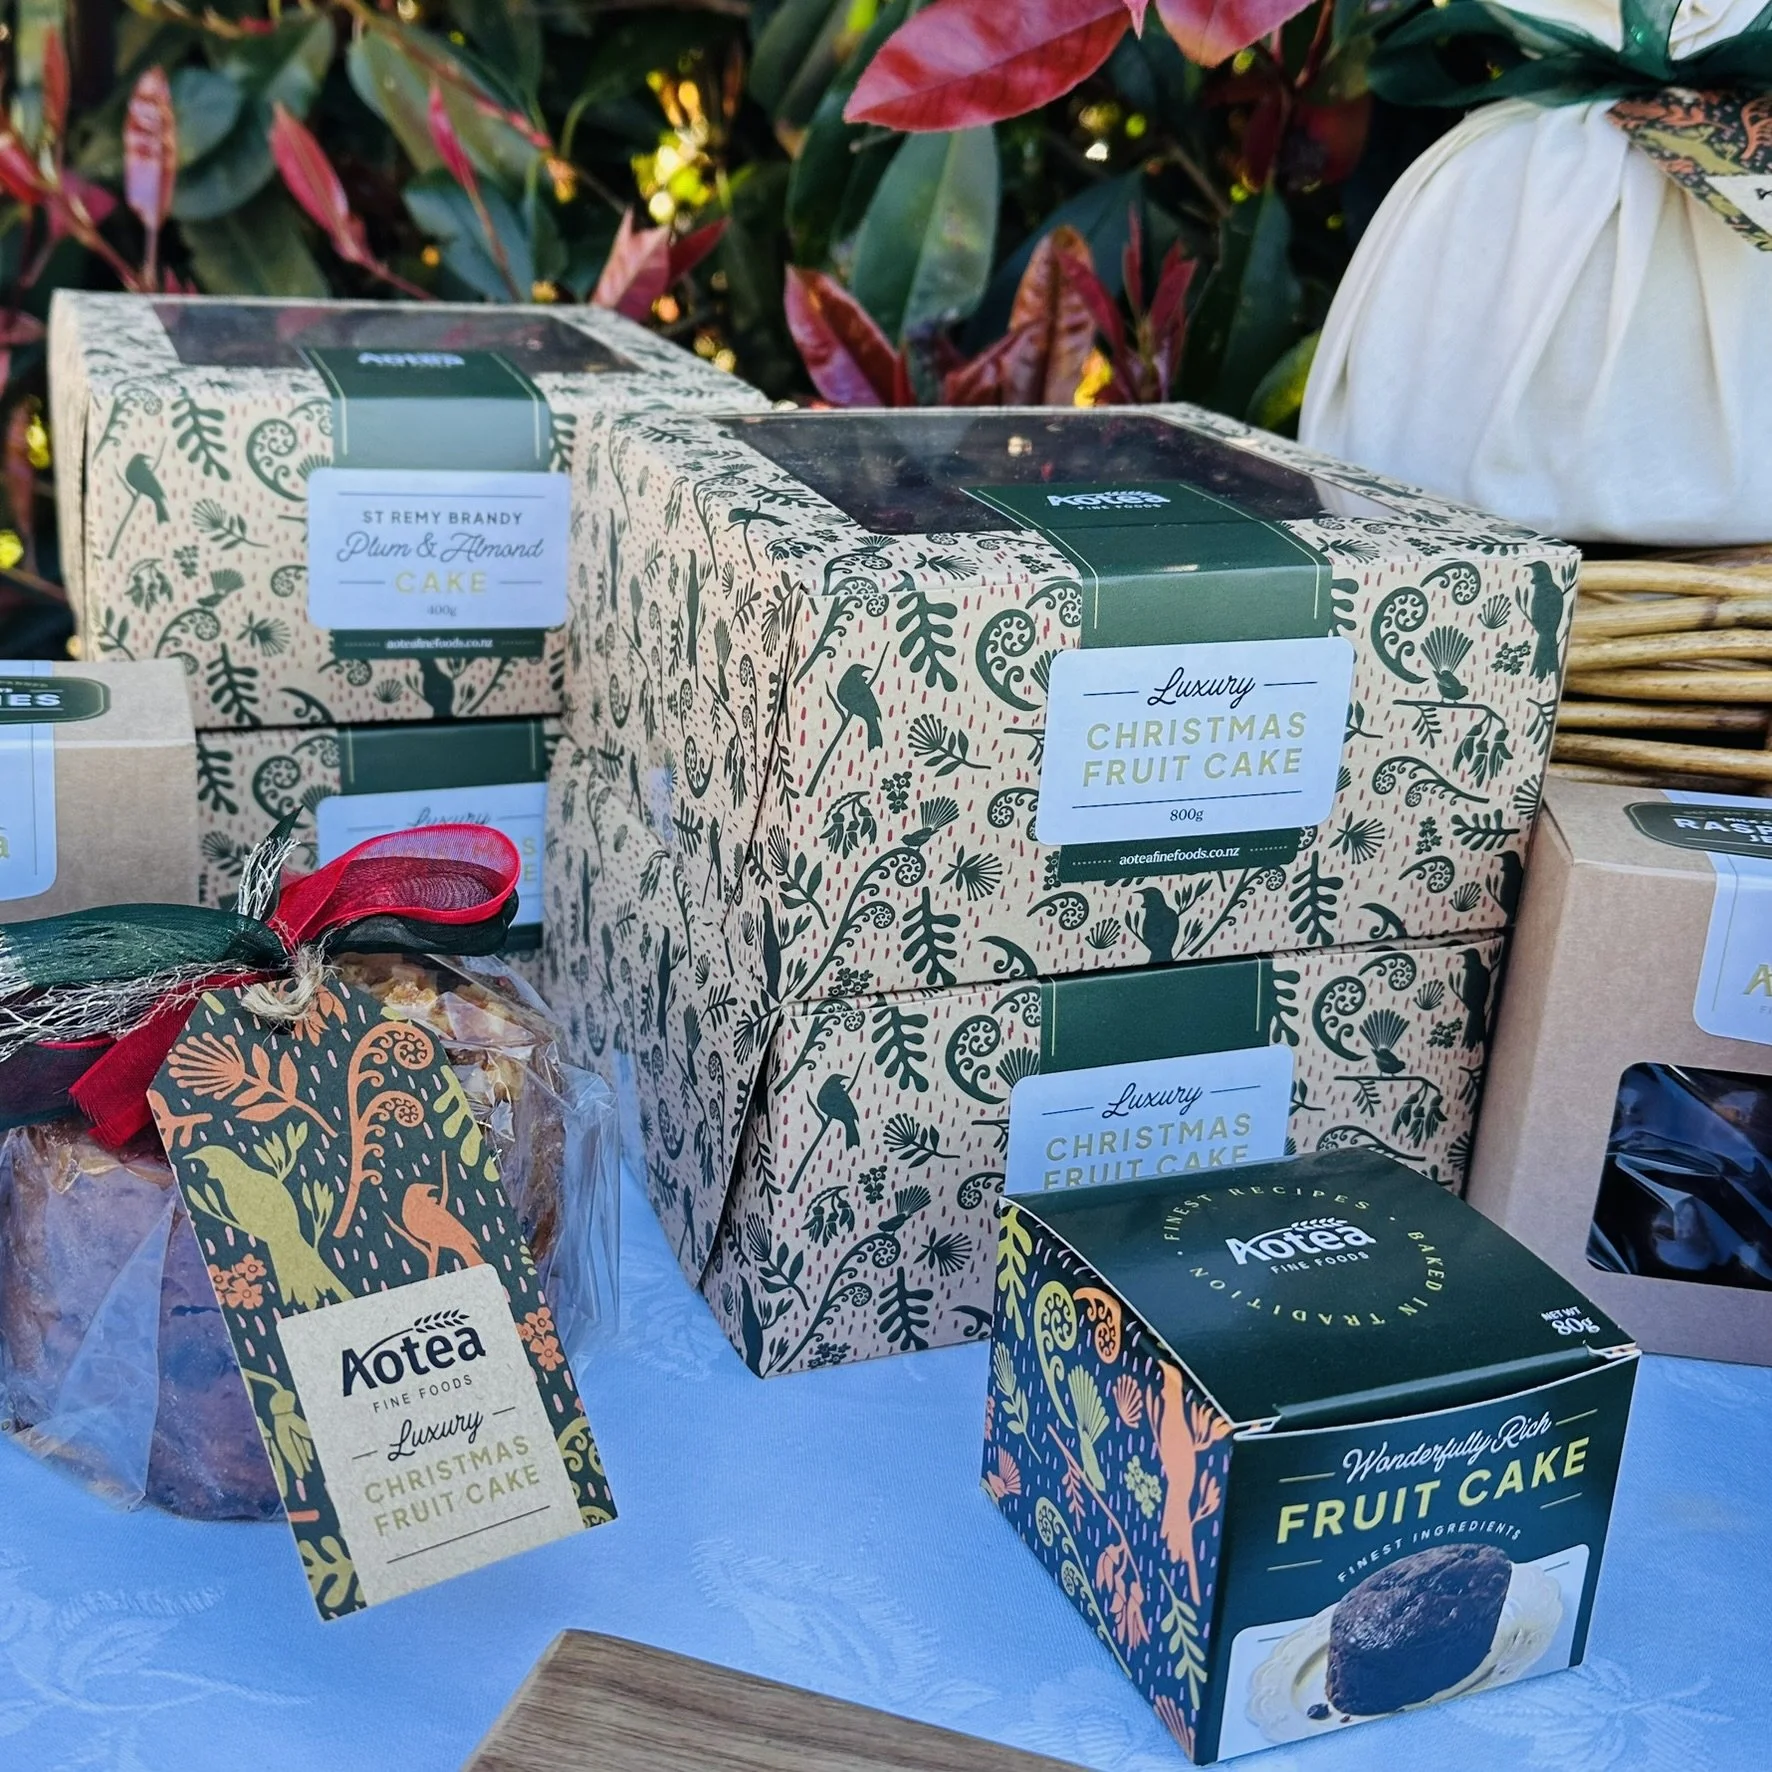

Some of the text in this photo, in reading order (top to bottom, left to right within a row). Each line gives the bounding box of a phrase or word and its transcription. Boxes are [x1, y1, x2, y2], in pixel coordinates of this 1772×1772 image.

[363, 510, 523, 525] ST REMY BRANDY
[1047, 490, 1171, 506] Aotea
[337, 531, 544, 562] Plum & Almond
[395, 571, 488, 594] CAKE
[1146, 666, 1256, 709] Luxury
[1086, 711, 1308, 751] CHRISTMAS
[1082, 747, 1303, 788] FRUIT CAKE
[1168, 808, 1205, 823] 800g
[1119, 845, 1240, 866] aoteafinefoods.co.nz
[1101, 1082, 1203, 1119] Luxury
[1045, 1112, 1251, 1162] CHRISTMAS
[1042, 1144, 1249, 1191] FRUIT CAKE
[1163, 1185, 1445, 1327] FINEST RECIPES BAKED IN TRADITION
[1225, 1224, 1377, 1266] Aotea
[1270, 1251, 1369, 1275] FINE FOODS
[1551, 1316, 1600, 1336] 80g
[341, 1322, 487, 1398] Aotea
[372, 1374, 473, 1413] FINE FOODS
[387, 1410, 484, 1462] Luxury
[1342, 1411, 1553, 1484] Wonderfully Rich
[363, 1434, 531, 1505] CHRISTMAS
[373, 1463, 541, 1537] FRUIT CAKE
[1276, 1436, 1591, 1545] FRUIT CAKE
[1337, 1520, 1522, 1583] FINEST INGREDIENTS
